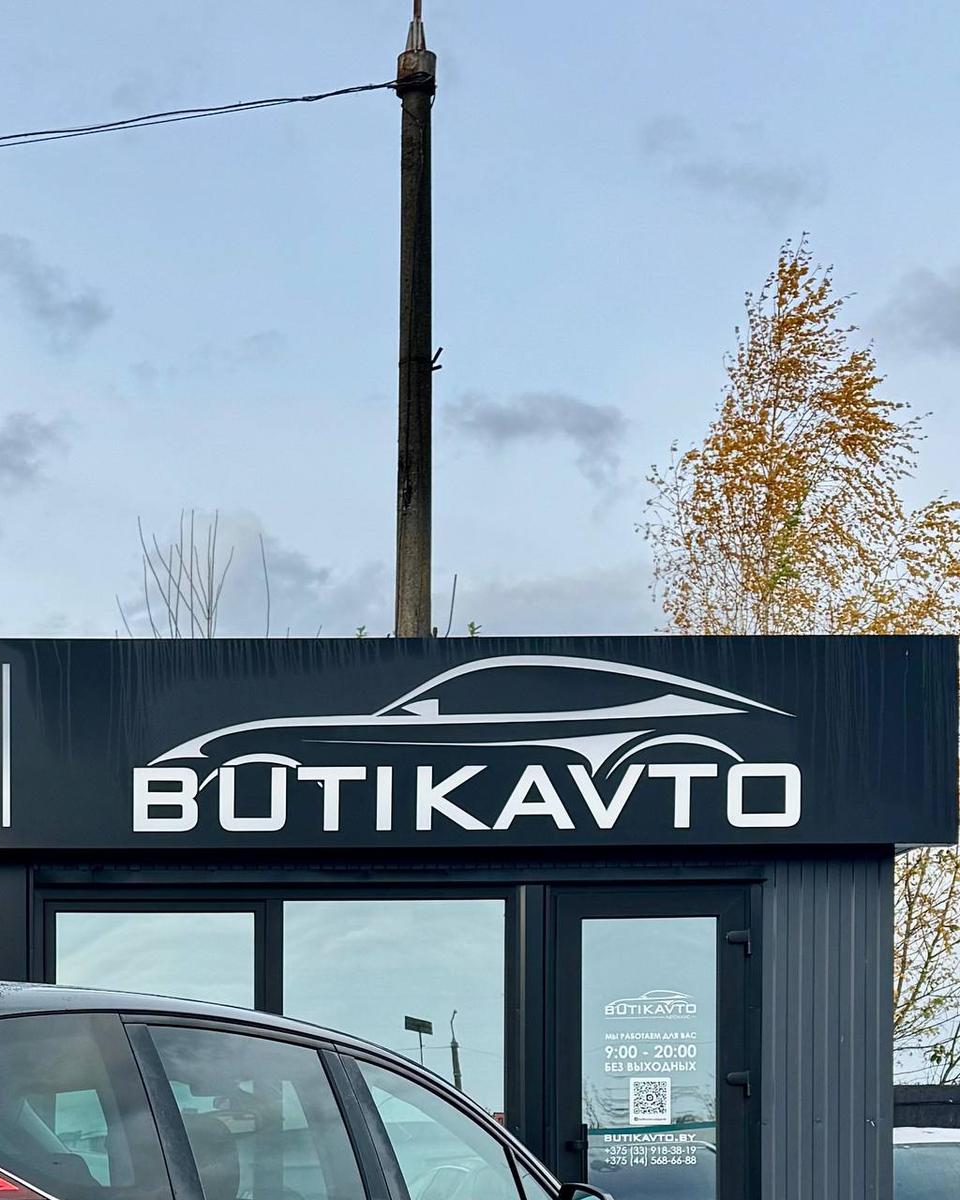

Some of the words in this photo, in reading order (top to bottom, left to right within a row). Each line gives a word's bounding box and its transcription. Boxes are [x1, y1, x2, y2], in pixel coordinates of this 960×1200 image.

[132, 763, 803, 832] BUTIKAVTO
[605, 1003, 697, 1015] BUTIKAVTO
[605, 1032, 619, 1040] МЫ
[620, 1032, 661, 1040] РАБОТАЕМ
[662, 1032, 679, 1040] ДЛЯ
[680, 1031, 697, 1039] ВАС
[604, 1045, 638, 1059] 9:00
[654, 1044, 697, 1058] 20:00
[604, 1062, 624, 1072] БЕЗ
[626, 1061, 697, 1072] ВЫХОДНЫХ
[603, 1133, 697, 1142] BUTIKAVTO.BY
[604, 1146, 627, 1155] +375
[630, 1146, 648, 1156] (33)
[650, 1146, 697, 1155] 918-38-19
[604, 1156, 627, 1165] +375
[630, 1156, 648, 1167] (44)
[650, 1156, 697, 1165] 568-66-88
